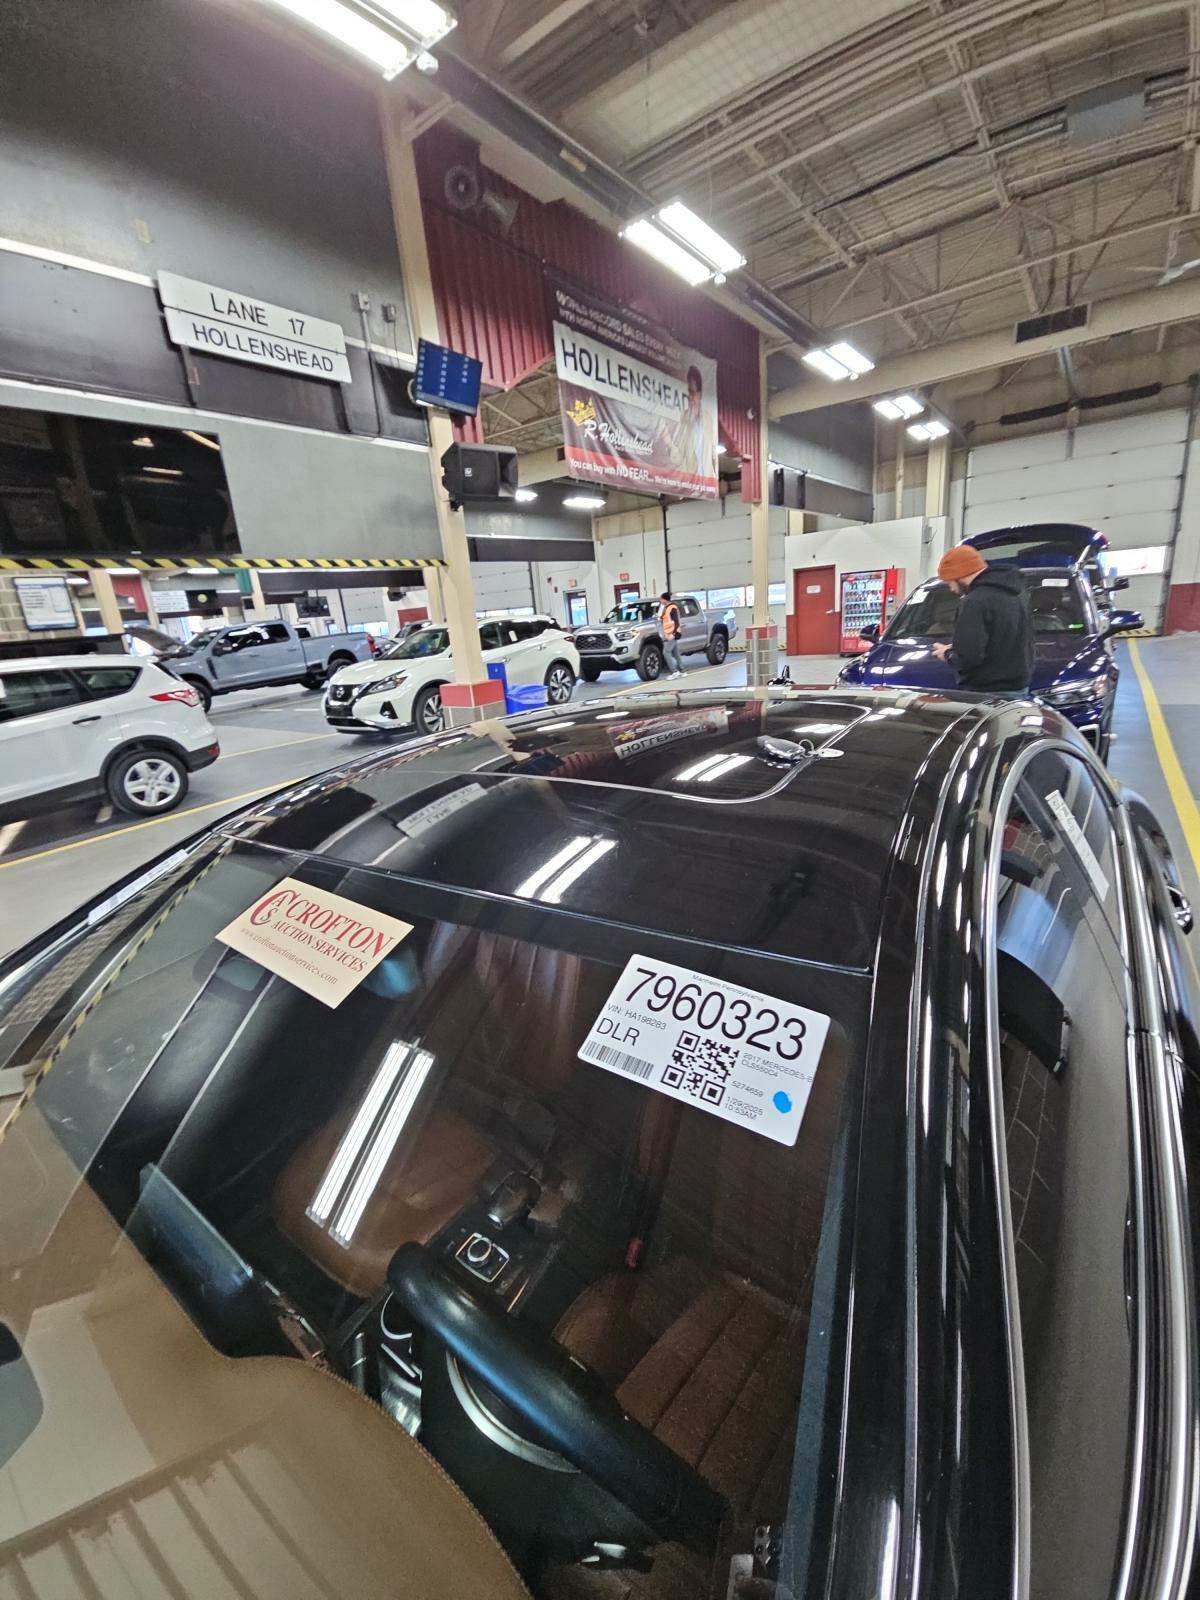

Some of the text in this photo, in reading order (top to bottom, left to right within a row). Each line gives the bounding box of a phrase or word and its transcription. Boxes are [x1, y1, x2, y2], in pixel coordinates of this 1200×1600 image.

[210, 292, 305, 337] LANE 17
[192, 322, 335, 373] HOLLENSHEAD
[561, 338, 690, 412] HOLLENSHEAD
[584, 419, 599, 441] R.
[616, 463, 629, 478] NO
[270, 920, 368, 973] AUCTION SERVICES
[286, 899, 394, 958] CROFTON
[596, 1017, 640, 1047] DLR
[625, 967, 807, 1061] 7960323
